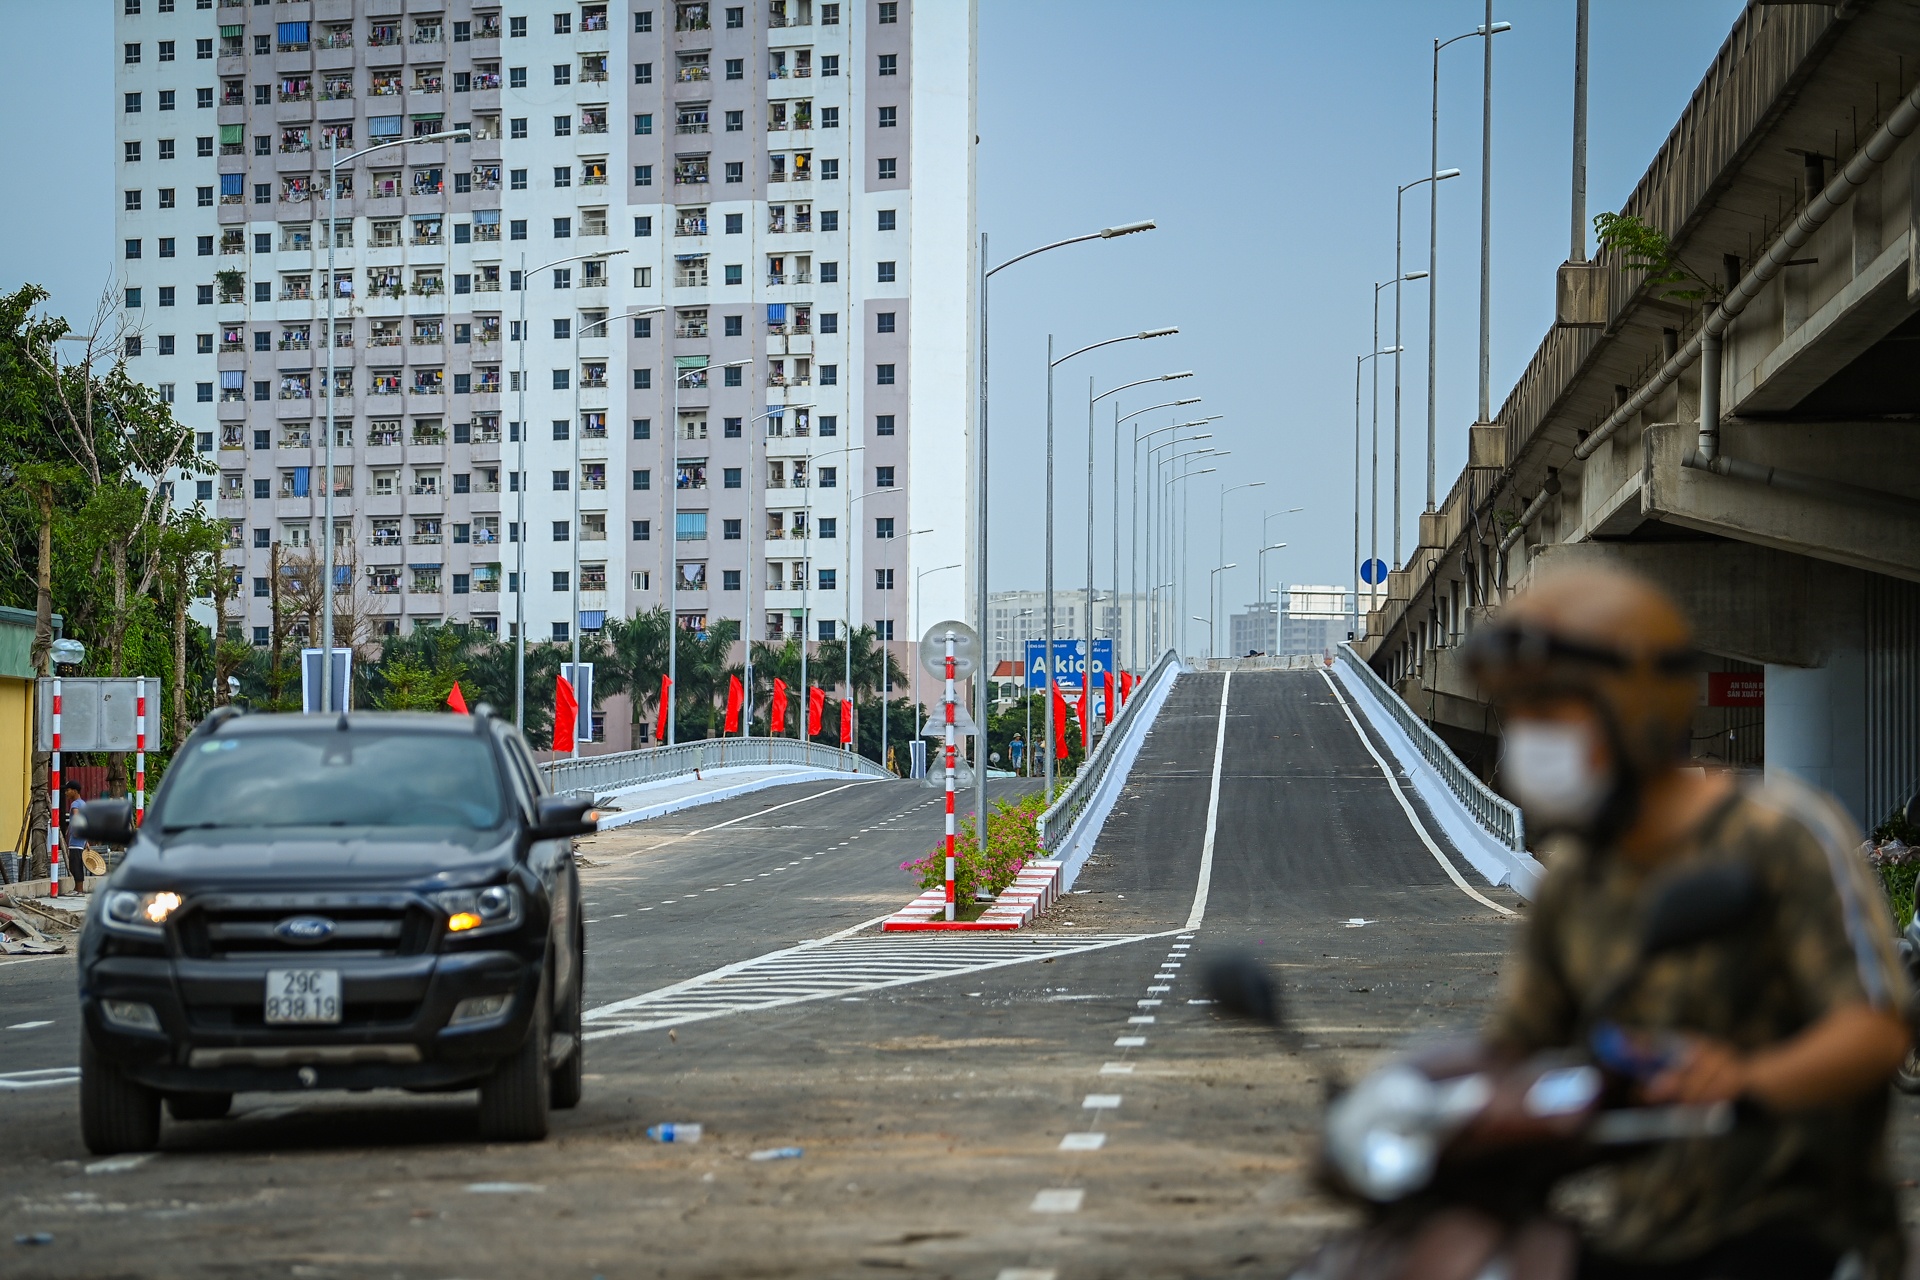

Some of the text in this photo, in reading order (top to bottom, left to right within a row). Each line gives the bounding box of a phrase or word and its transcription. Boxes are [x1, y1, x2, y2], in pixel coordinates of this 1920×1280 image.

[1032, 654, 1103, 674] Akido
[1730, 681, 1740, 689] AN
[283, 971, 321, 993] 29C
